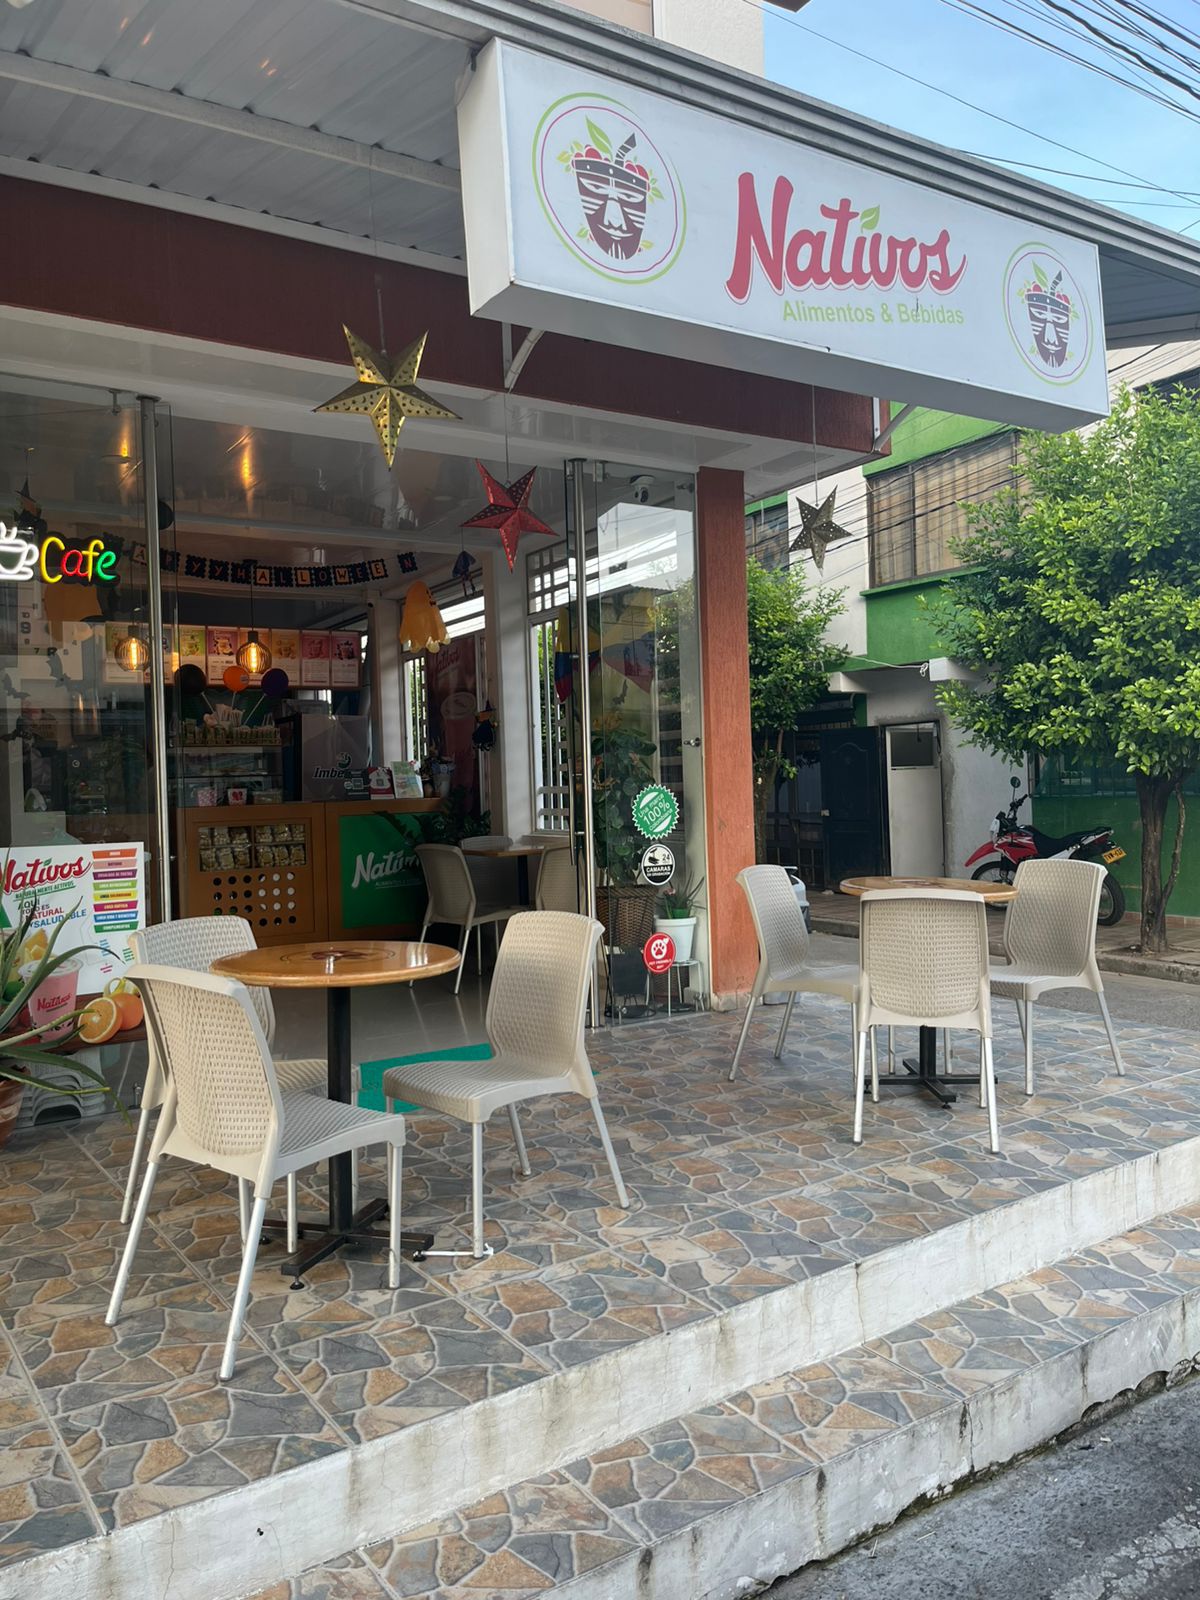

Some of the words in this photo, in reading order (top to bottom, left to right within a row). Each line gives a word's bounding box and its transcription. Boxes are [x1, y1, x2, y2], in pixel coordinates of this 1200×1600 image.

[725, 171, 967, 305] Nativos
[782, 300, 876, 324] Alimentos
[881, 303, 894, 324] &
[897, 303, 965, 325] Bebidas
[39, 536, 117, 584] Cafe
[649, 793, 664, 809] marca
[643, 798, 671, 825] 100%
[646, 865, 671, 873] CAMARAS
[22, 905, 40, 914] TOO
[26, 907, 64, 920] ATURAL
